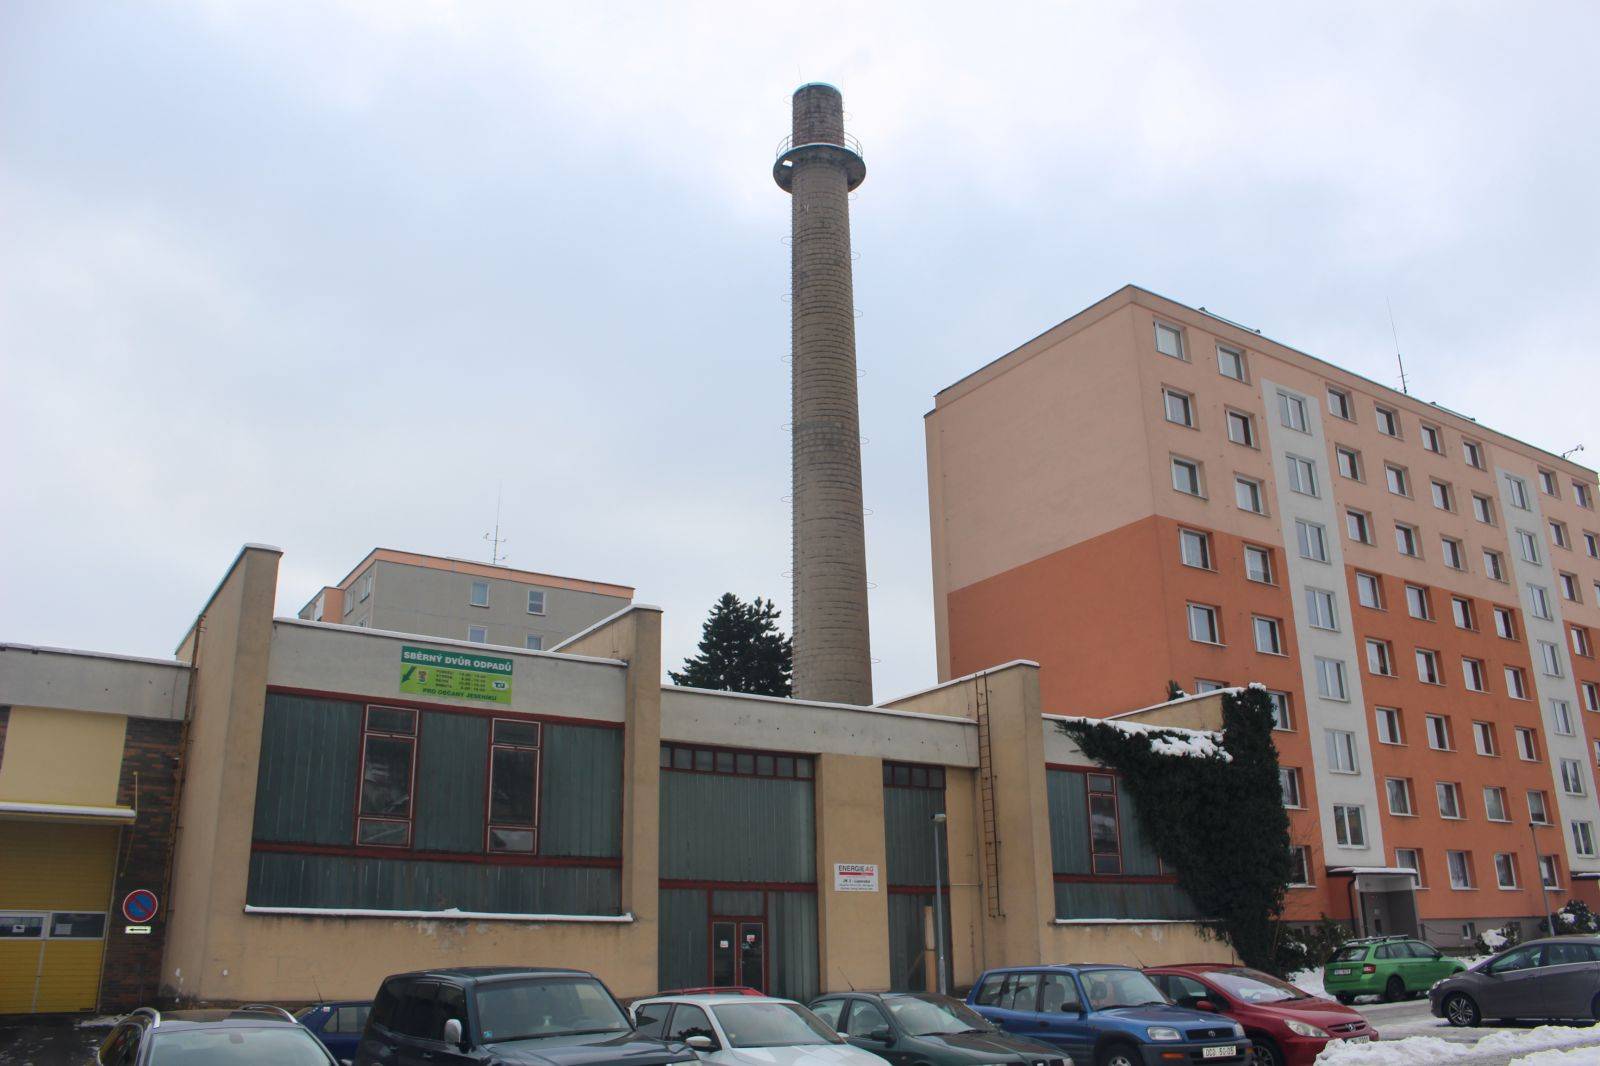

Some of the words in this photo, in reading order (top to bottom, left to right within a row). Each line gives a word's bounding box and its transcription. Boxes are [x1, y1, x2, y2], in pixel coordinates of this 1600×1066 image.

[403, 651, 443, 663] SBĚRNÝ
[445, 655, 471, 667] DVŮR
[473, 661, 512, 672] ODPADŮ
